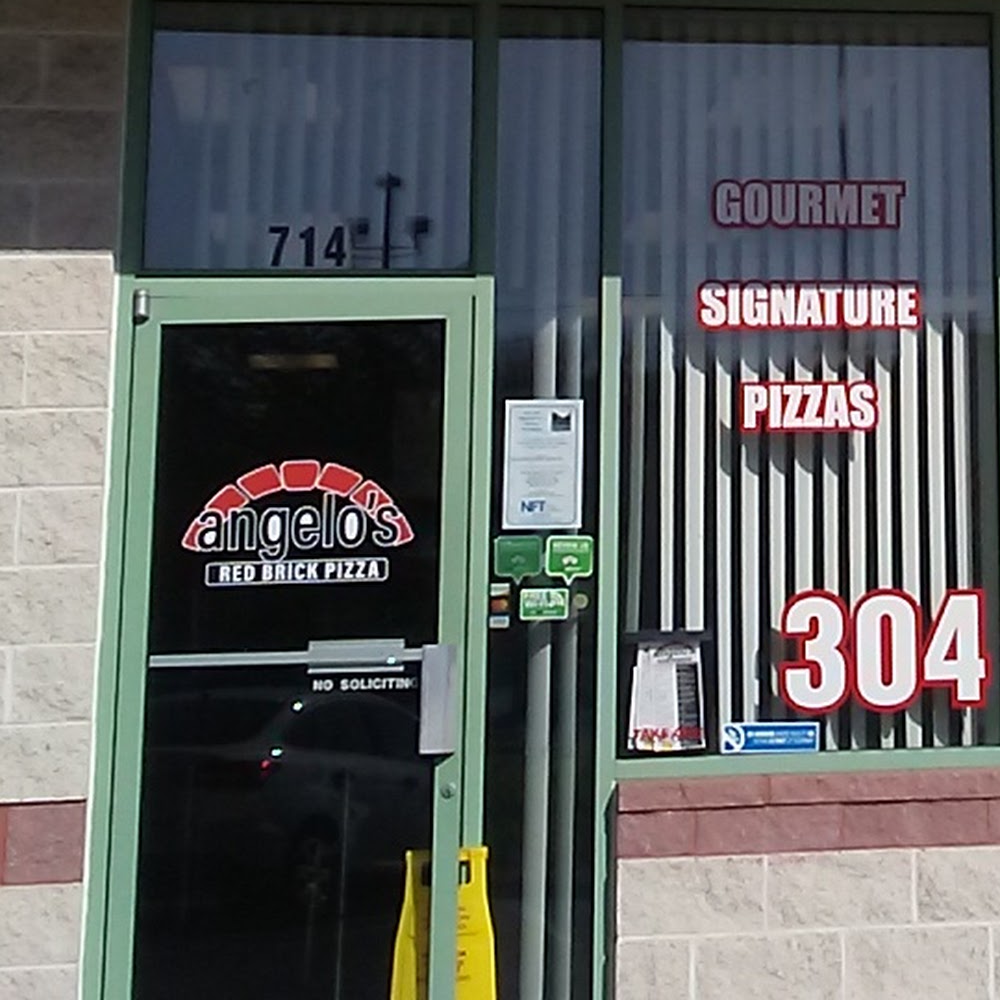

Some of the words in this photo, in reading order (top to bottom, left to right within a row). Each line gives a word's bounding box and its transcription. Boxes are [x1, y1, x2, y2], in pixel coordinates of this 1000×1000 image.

[712, 179, 906, 229] GOURMET
[267, 225, 347, 268] 714
[697, 281, 920, 331] SIGNATURE
[741, 381, 878, 431] PIZZAS
[196, 490, 400, 562] angelo's
[219, 566, 256, 582] RED
[262, 563, 320, 581] BRICK
[325, 561, 380, 580] PIZZA
[782, 589, 990, 713] 304
[312, 679, 334, 692] NO
[340, 677, 418, 692] SOLICITING
